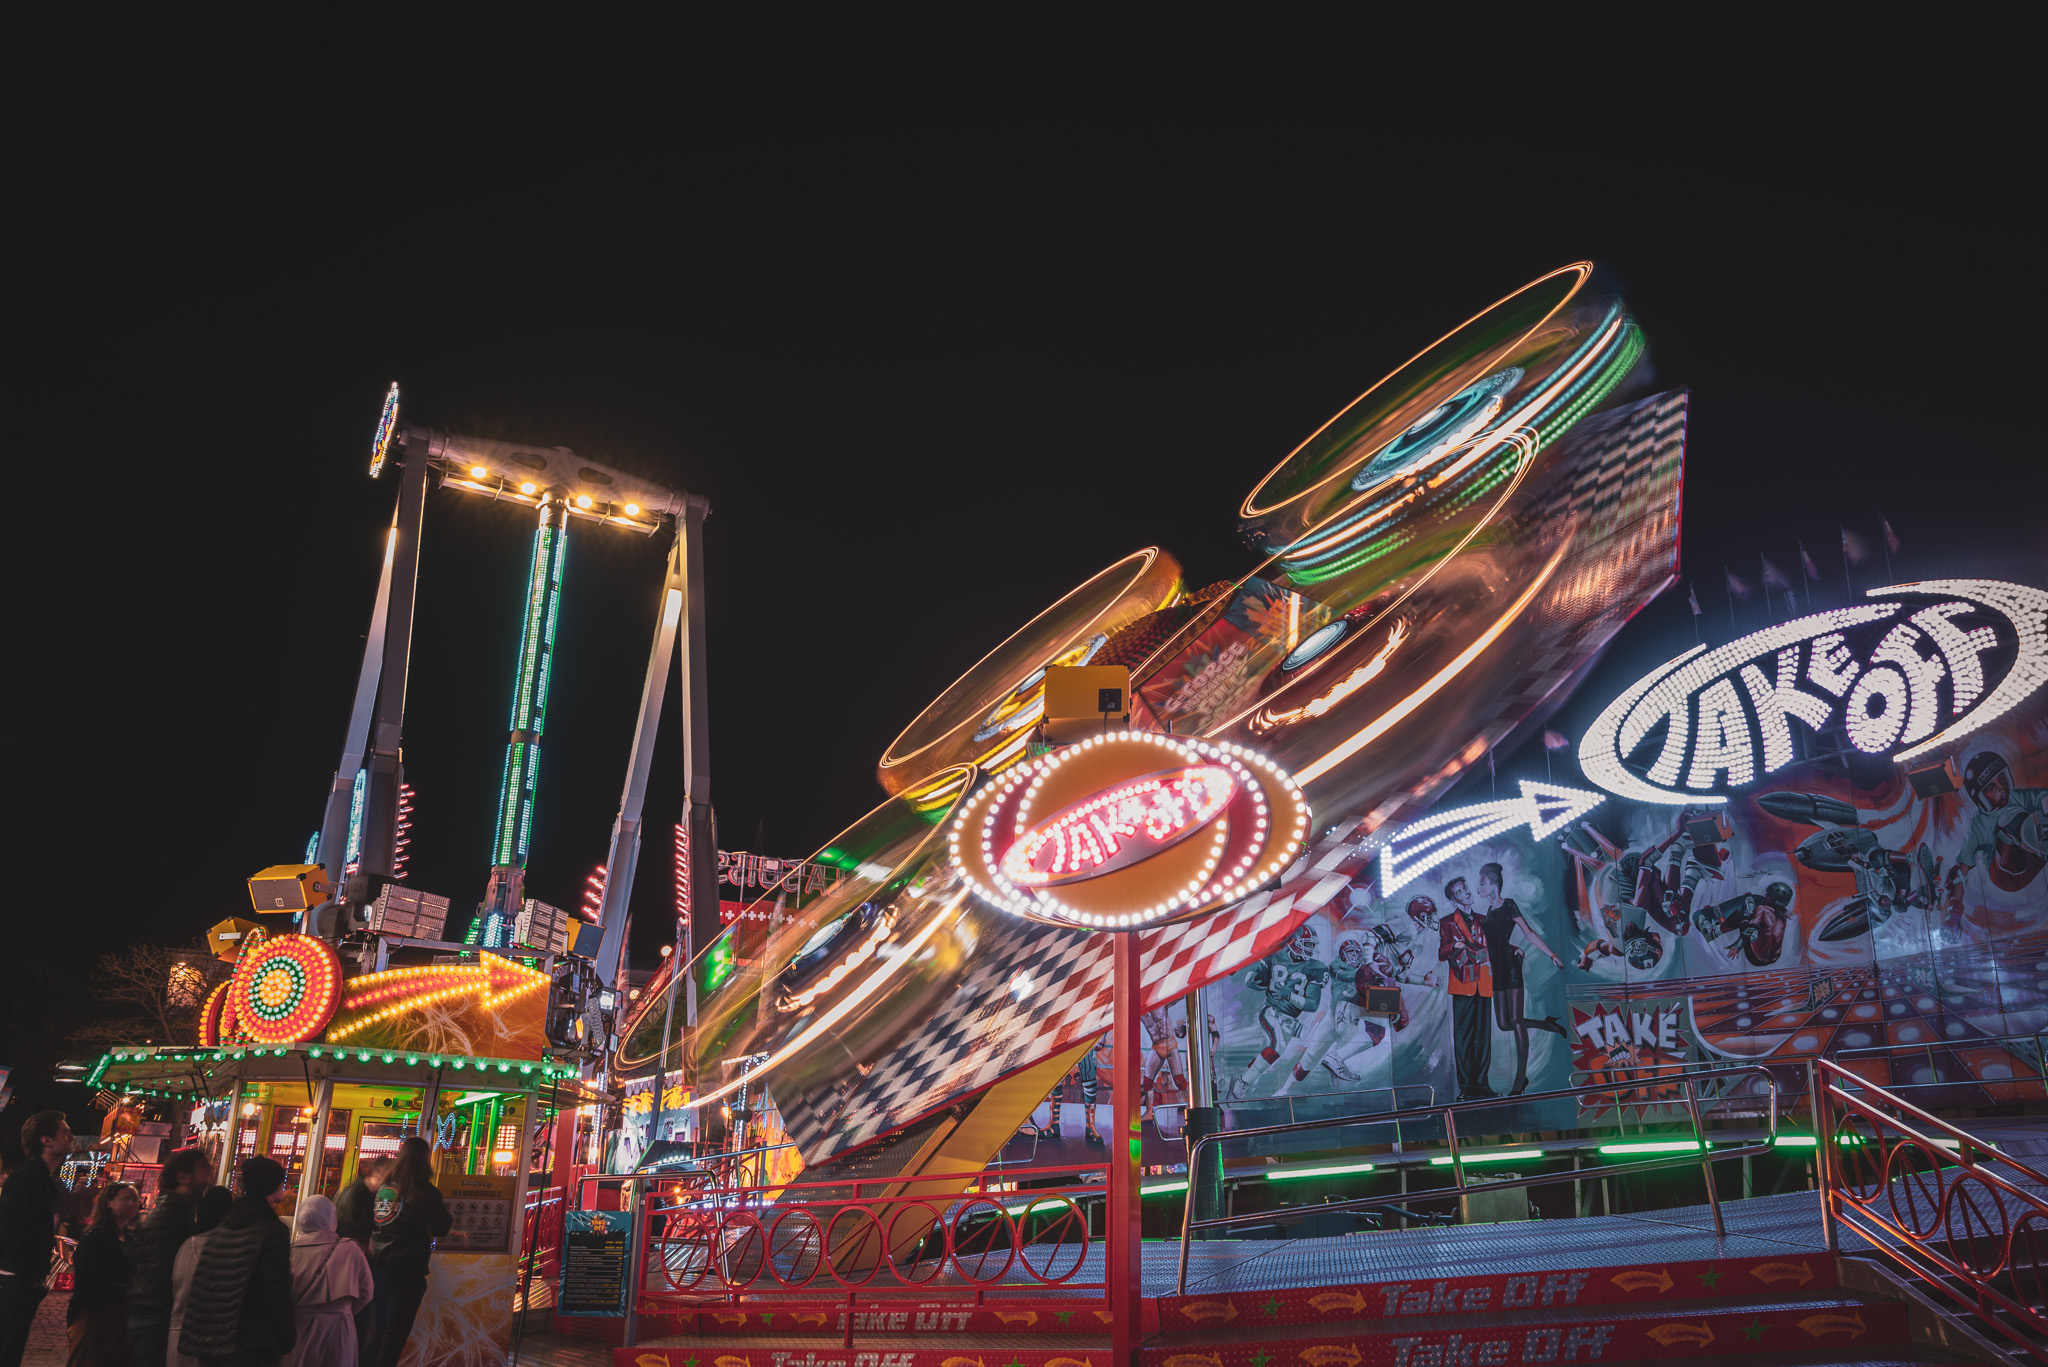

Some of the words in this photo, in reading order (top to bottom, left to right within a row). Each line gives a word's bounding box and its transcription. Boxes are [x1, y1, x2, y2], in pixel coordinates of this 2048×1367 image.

[1164, 640, 1249, 713] G-FORCE
[1196, 666, 1250, 714] FULL
[1576, 1011, 1679, 1050] TAKE
[1588, 1054, 1684, 1100] OFF
[1379, 1281, 1493, 1316] Take
[1502, 1271, 1591, 1309] Off
[835, 1303, 909, 1331] Take
[914, 1303, 976, 1331] Off
[1389, 1333, 1511, 1367] Take
[1522, 1325, 1616, 1364] Off
